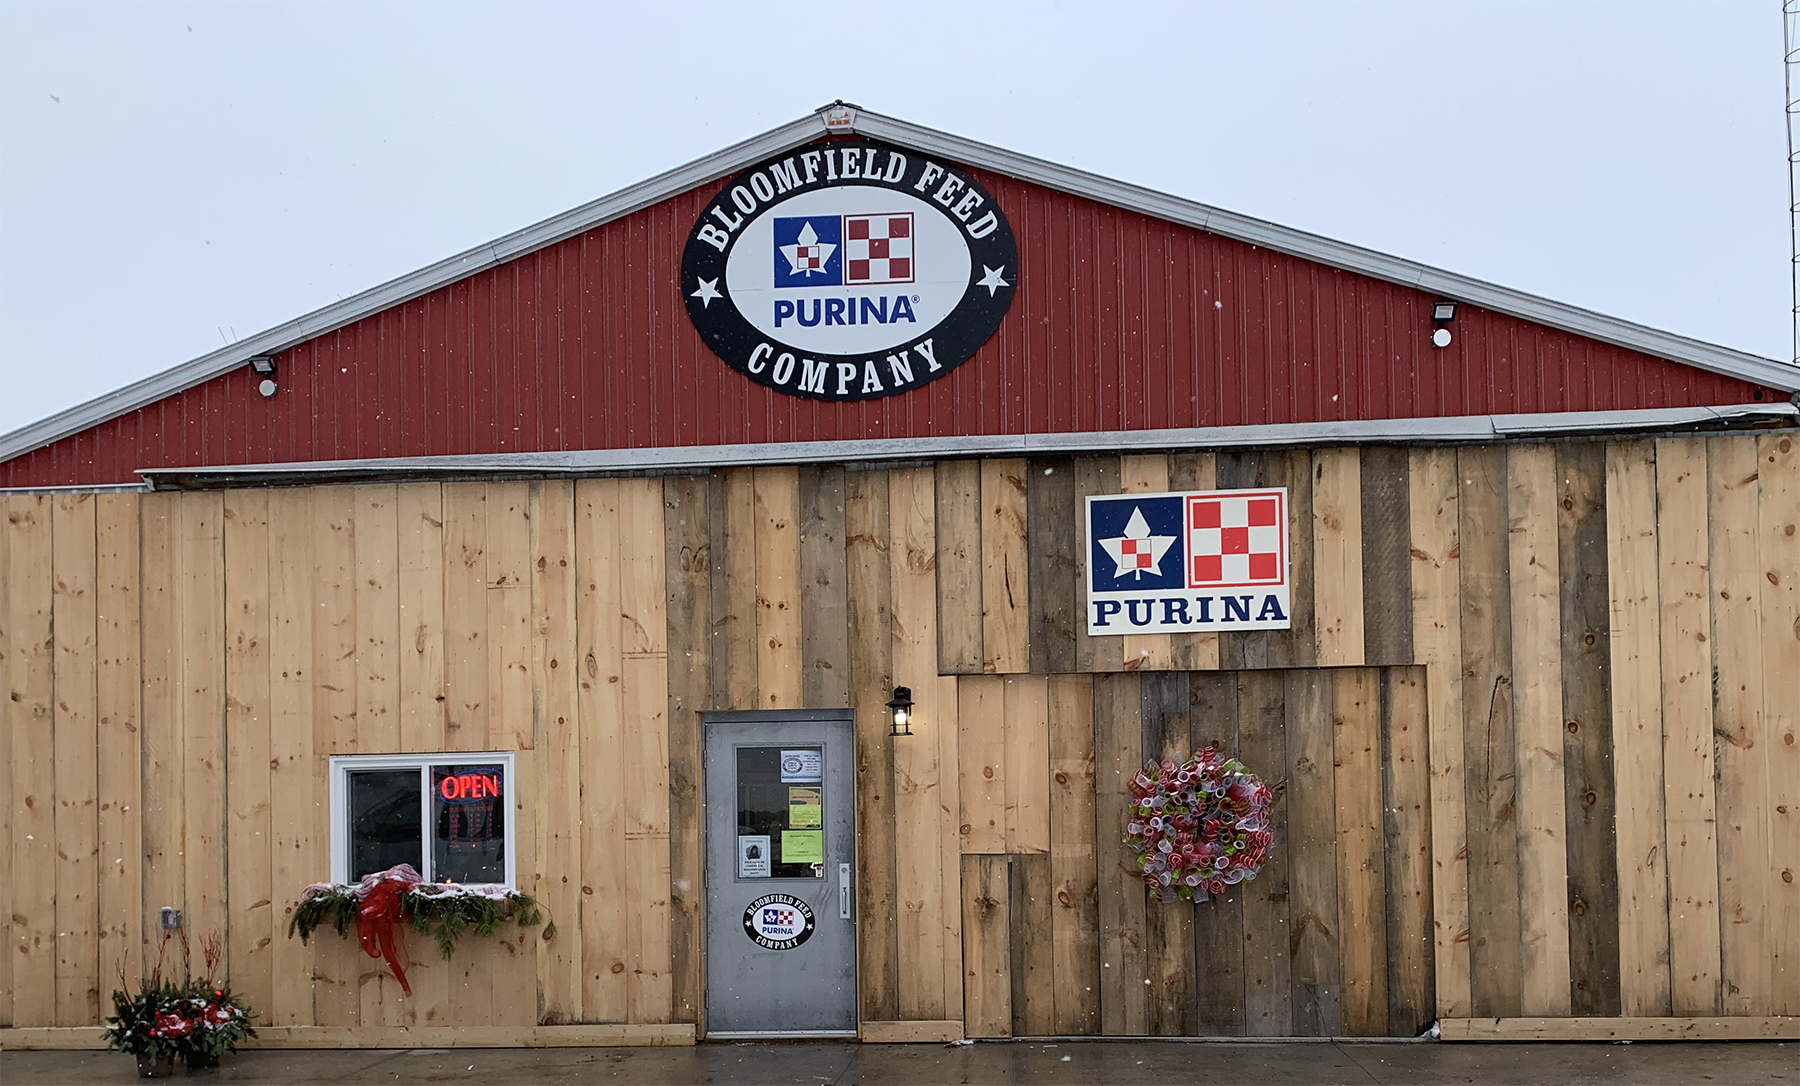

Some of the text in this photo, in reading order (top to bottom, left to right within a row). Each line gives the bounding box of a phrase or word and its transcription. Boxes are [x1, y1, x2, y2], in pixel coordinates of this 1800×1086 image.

[697, 147, 999, 252] BLOOMFIELD FEED
[747, 338, 942, 395] COMPANY
[1092, 594, 1288, 626] PURINA
[441, 774, 498, 799] OPEN
[746, 894, 812, 918] BLOOMFIELD FEED
[755, 935, 798, 949] COMPANY
[762, 926, 794, 935] PURINA
